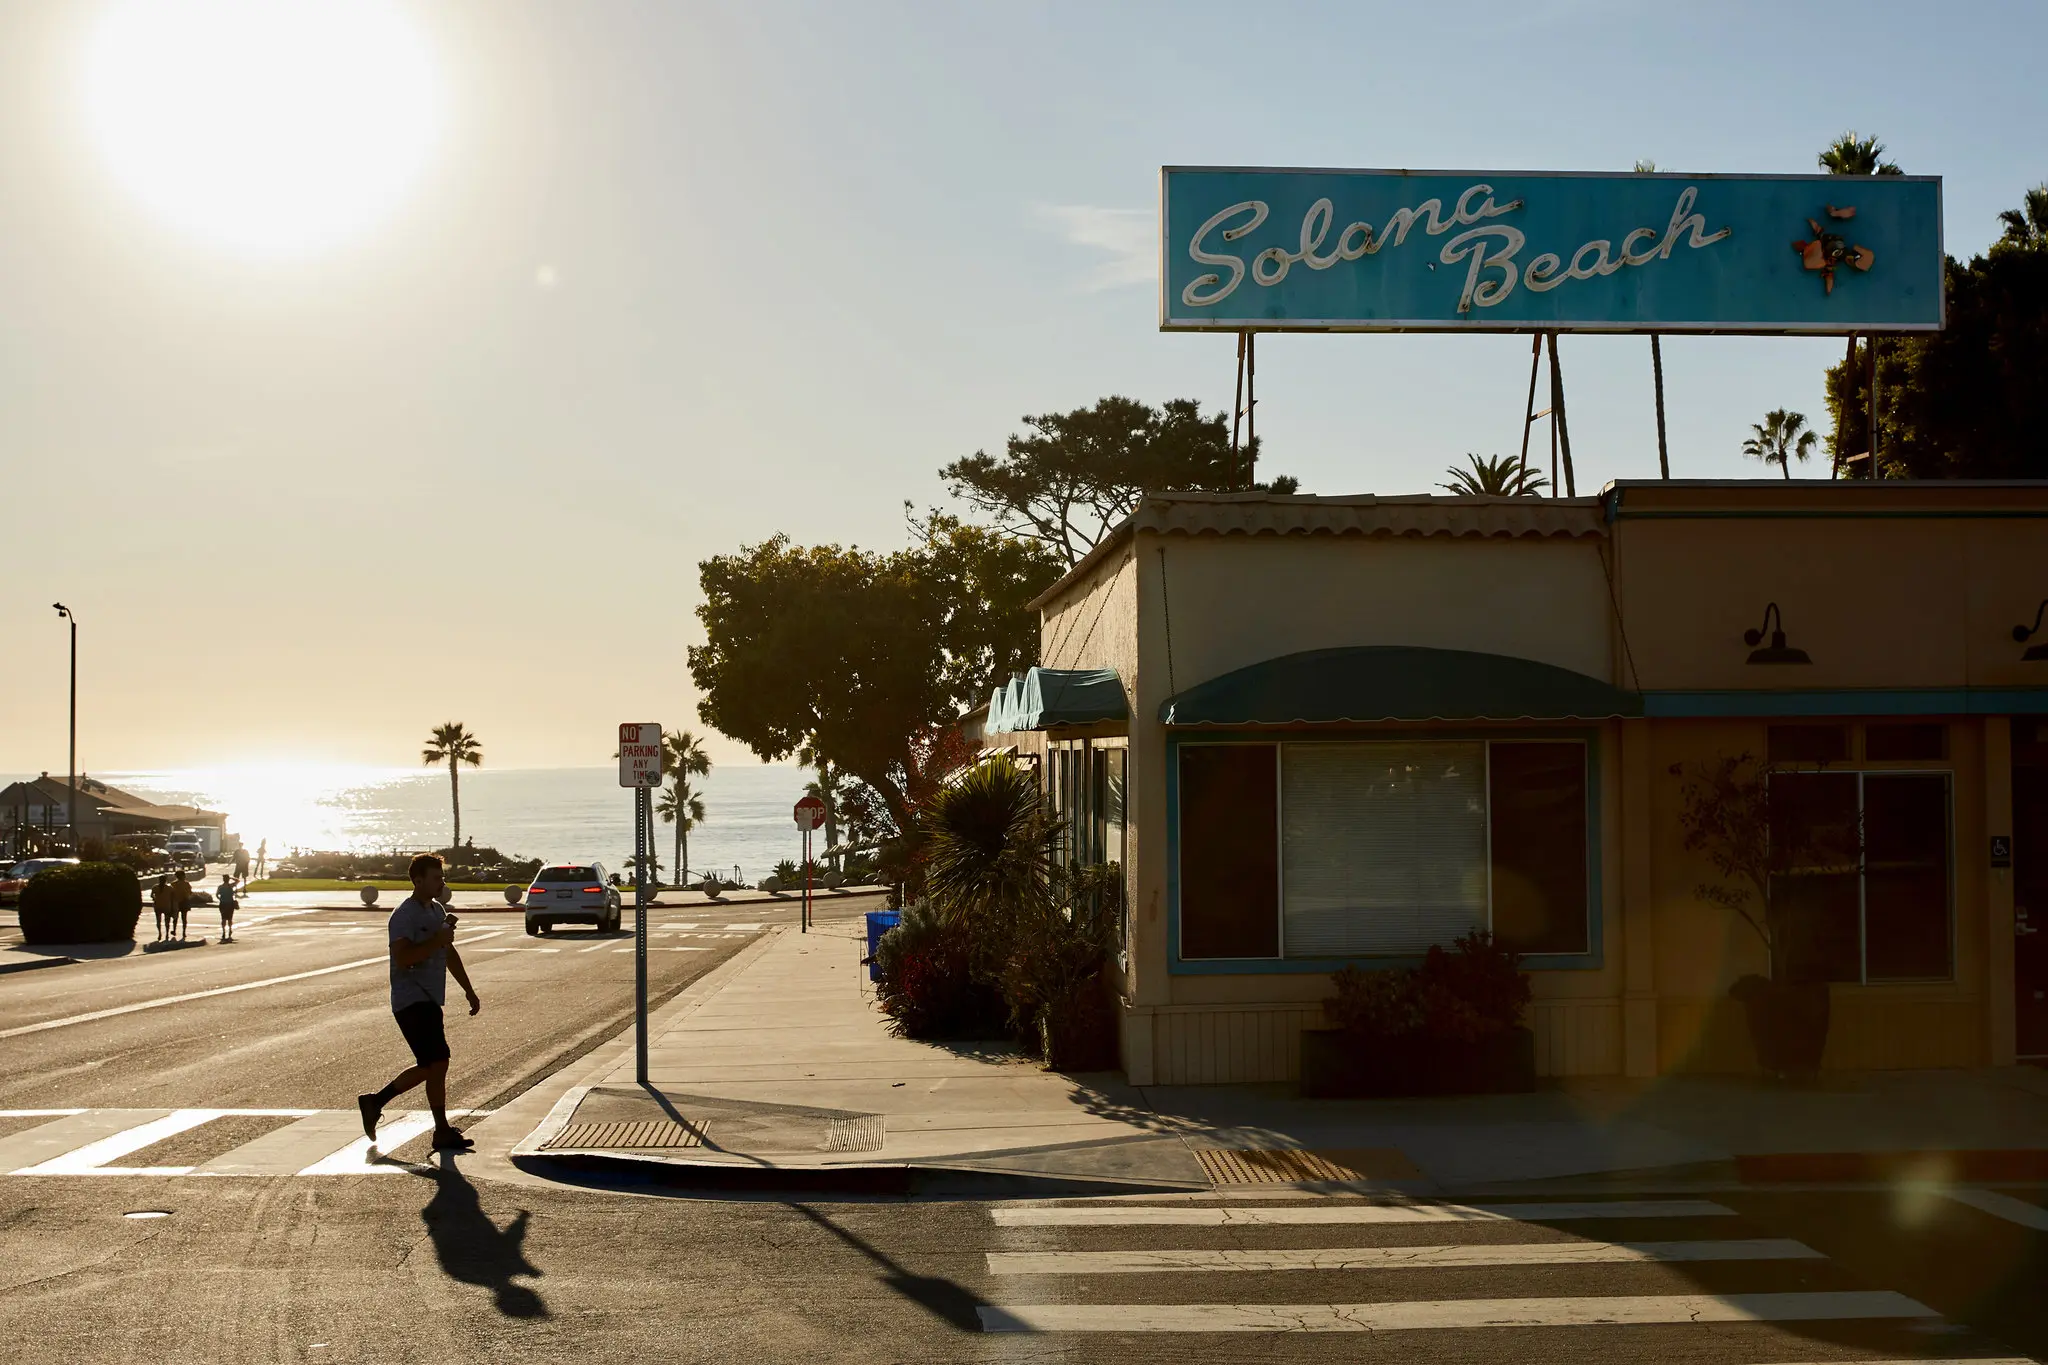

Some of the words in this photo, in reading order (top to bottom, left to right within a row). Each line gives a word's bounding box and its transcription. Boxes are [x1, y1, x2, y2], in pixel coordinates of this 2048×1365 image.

[1182, 184, 1524, 307] Solana
[1439, 186, 1732, 313] Beach
[622, 727, 636, 740] NO
[623, 745, 659, 757] PARKING
[633, 759, 648, 768] ANY
